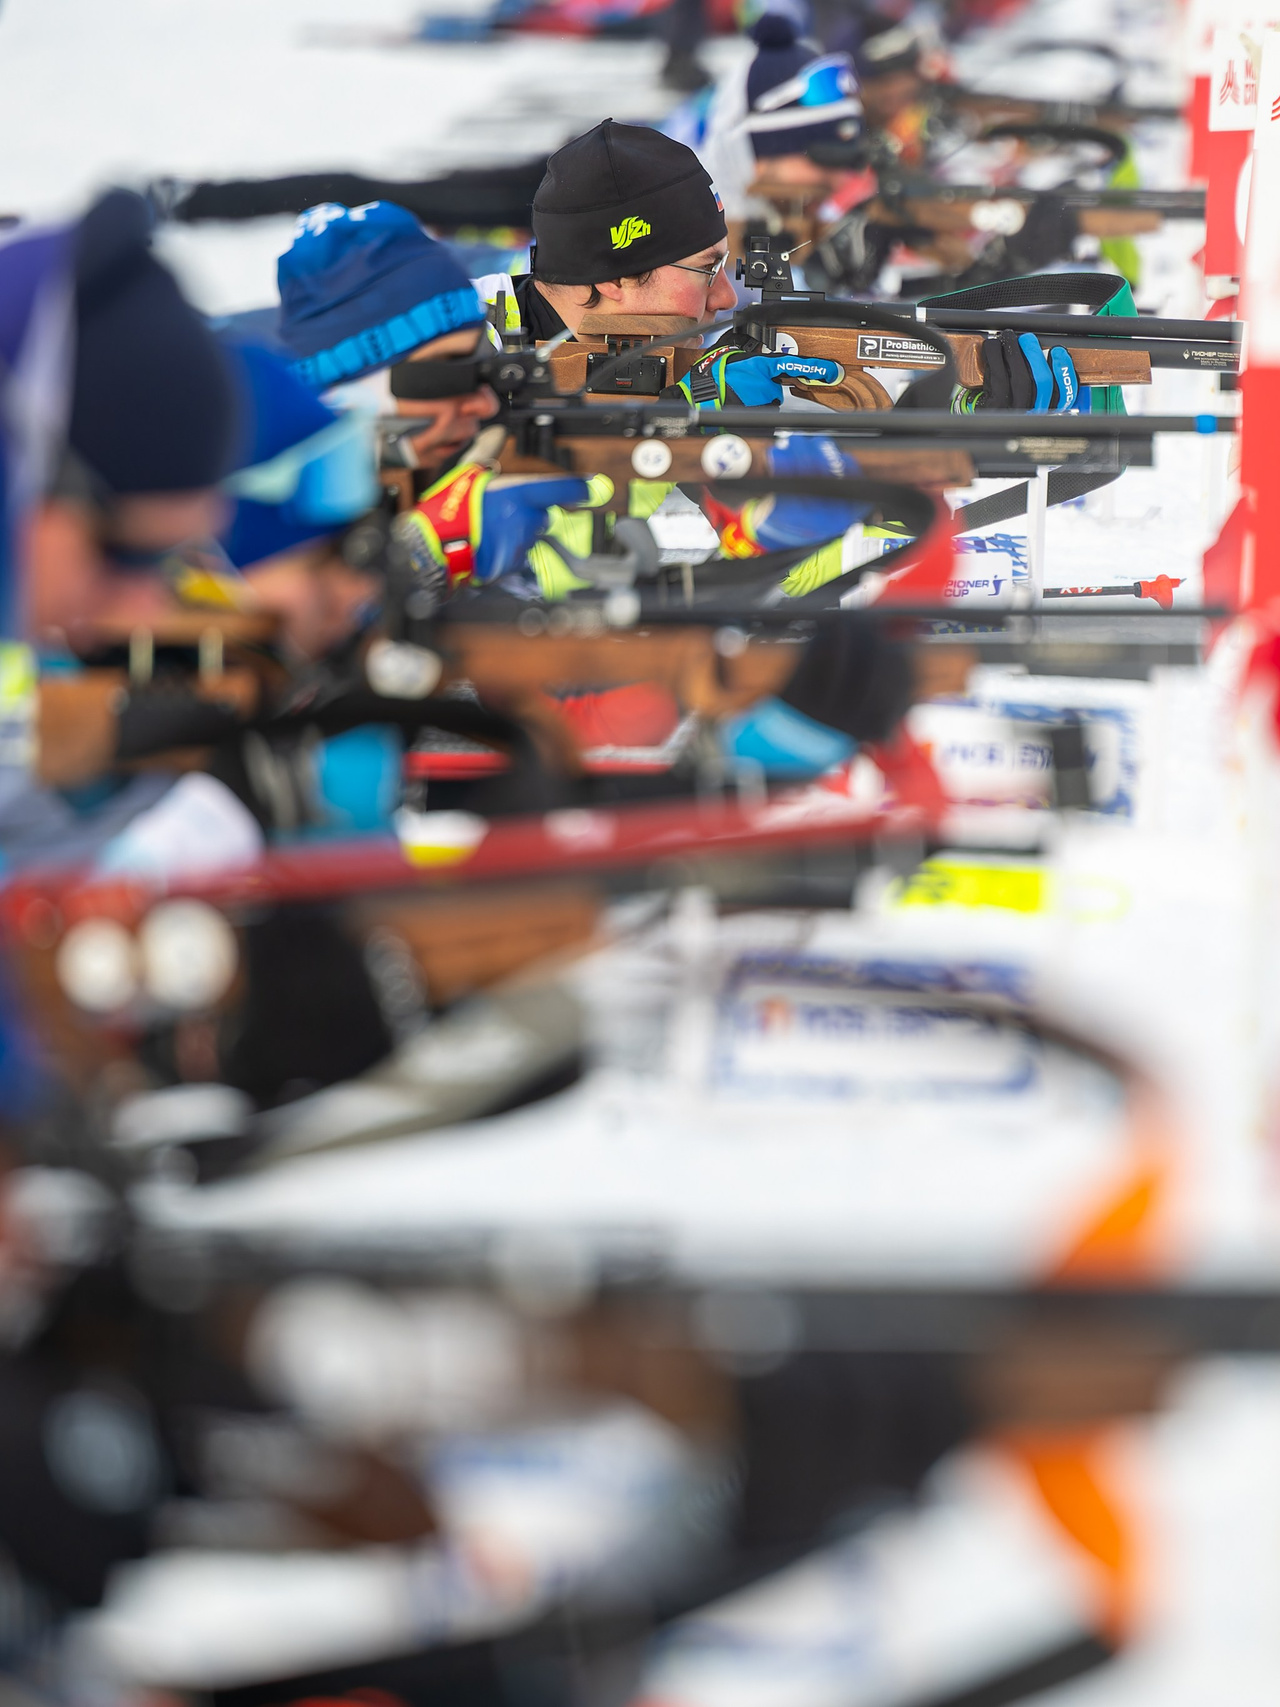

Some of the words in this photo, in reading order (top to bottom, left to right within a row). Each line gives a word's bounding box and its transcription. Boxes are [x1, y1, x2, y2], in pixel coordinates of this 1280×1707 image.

[886, 340, 940, 352] ProBiathlo
[776, 362, 827, 375] NORDSKI
[1061, 366, 1074, 410] NORD
[945, 579, 989, 588] PIONER
[944, 588, 969, 598] CUP
